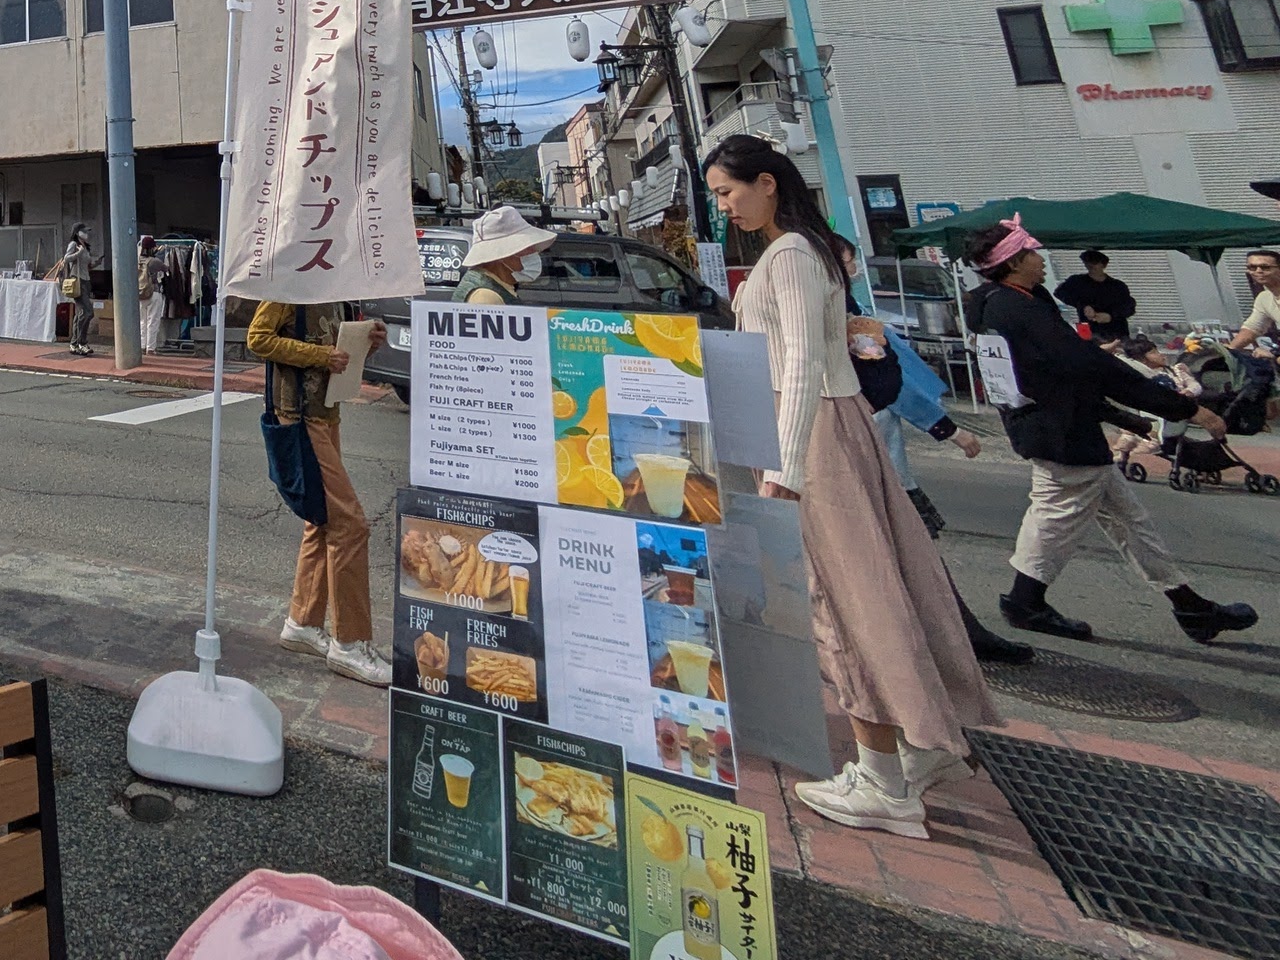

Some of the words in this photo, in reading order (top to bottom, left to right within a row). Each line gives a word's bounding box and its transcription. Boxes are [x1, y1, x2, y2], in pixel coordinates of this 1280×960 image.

[364, 3, 378, 37] very
[274, 26, 285, 52] are
[268, 61, 283, 85] We
[368, 45, 385, 81] much
[371, 89, 381, 110] as
[1076, 83, 1213, 103] Pharmacy
[264, 98, 283, 166] coming.
[365, 117, 381, 143] you
[367, 154, 377, 178] are
[257, 176, 272, 206] for
[366, 187, 385, 276] delicious.
[248, 217, 268, 279] Thanks
[428, 311, 532, 342] MENU
[429, 340, 456, 349] FOOD
[510, 358, 533, 366] ¥1000
[429, 373, 453, 381] French
[510, 369, 533, 377] ¥1300
[429, 396, 450, 405] FUJI
[453, 397, 484, 409] CRAFT
[487, 401, 514, 411] BEER
[512, 422, 536, 430] ¥1000
[513, 433, 537, 441] ¥1300
[430, 440, 473, 453] Fujiyama
[476, 445, 495, 455] SET
[429, 469, 446, 477] Beer
[456, 472, 470, 480] size
[515, 480, 539, 488] ¥2000
[514, 468, 538, 477] ¥1800
[436, 507, 495, 527] FISH&CHIPS
[558, 537, 615, 559] DRINK
[559, 554, 612, 575] MENU
[444, 591, 484, 610] ¥1000
[410, 605, 433, 621] FISH
[410, 617, 429, 631] FRY
[467, 618, 507, 638] FRENCH
[467, 631, 498, 648] FRIES
[416, 674, 449, 695] ¥600
[483, 690, 518, 712] ¥600
[420, 704, 444, 720] CRAFT
[448, 710, 468, 724] BEER
[441, 738, 454, 747] ON
[453, 741, 471, 754] TAP
[536, 734, 587, 757] FISH&CHIPS
[725, 820, 752, 837] 山梨
